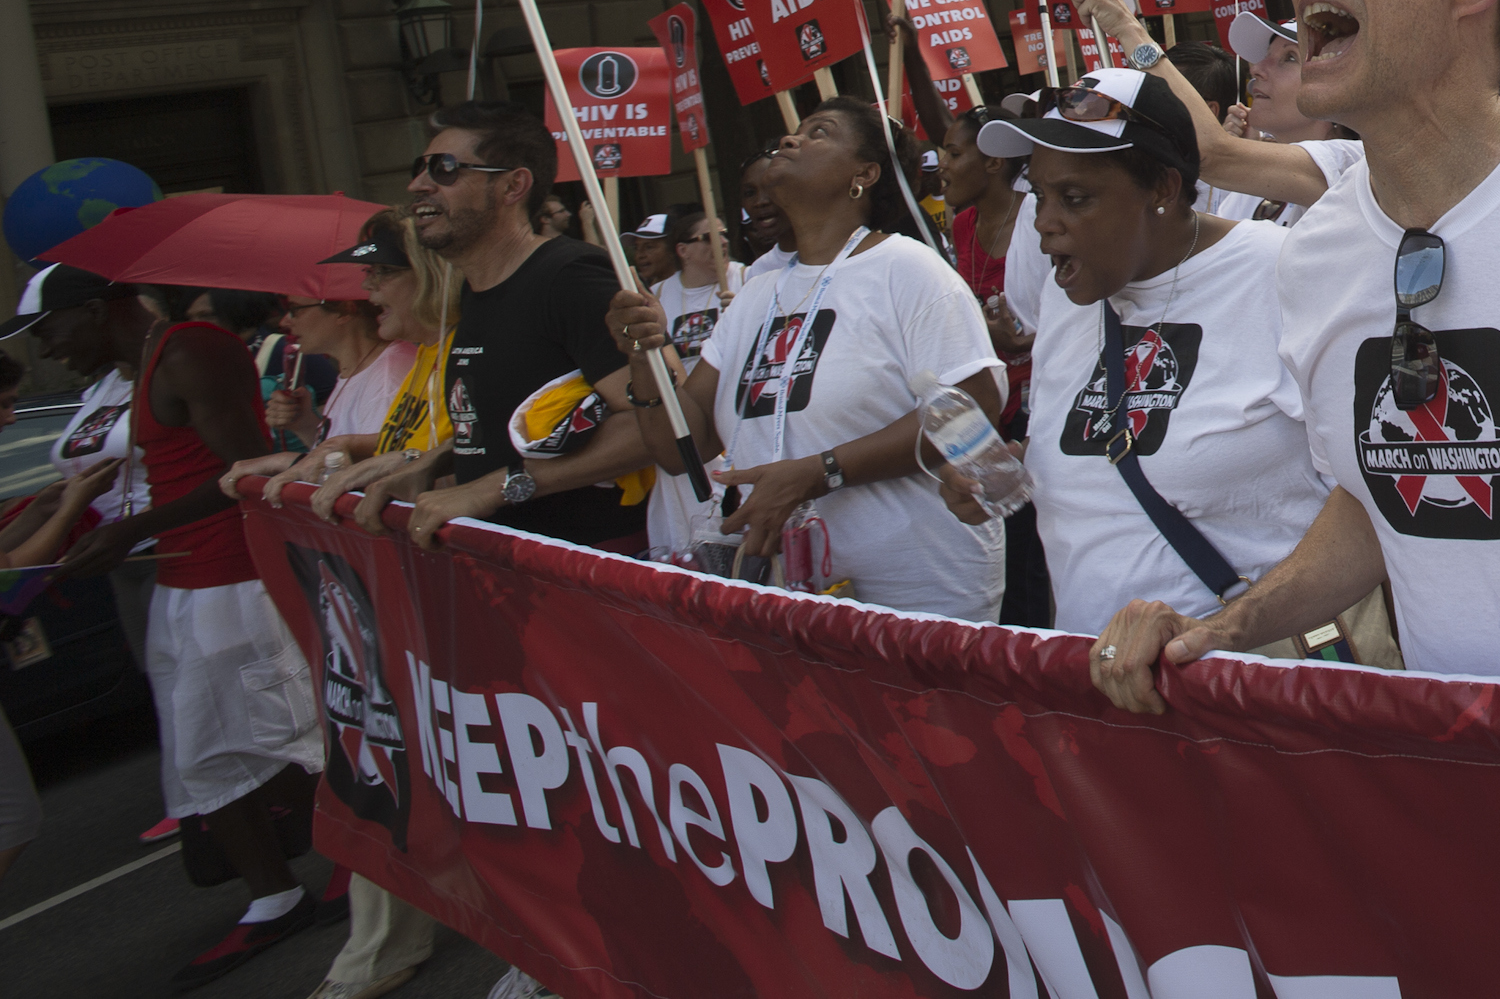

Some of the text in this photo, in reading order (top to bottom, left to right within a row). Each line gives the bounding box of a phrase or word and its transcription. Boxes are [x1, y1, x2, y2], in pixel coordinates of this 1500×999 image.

[913, 6, 985, 30] ONTROL
[930, 27, 973, 47] AIDS
[65, 44, 228, 71] POST OFFICE
[68, 60, 228, 89] DEPARTMENT
[572, 103, 648, 122] HIV IS
[1366, 448, 1413, 470] MARCH
[1413, 452, 1429, 470] on
